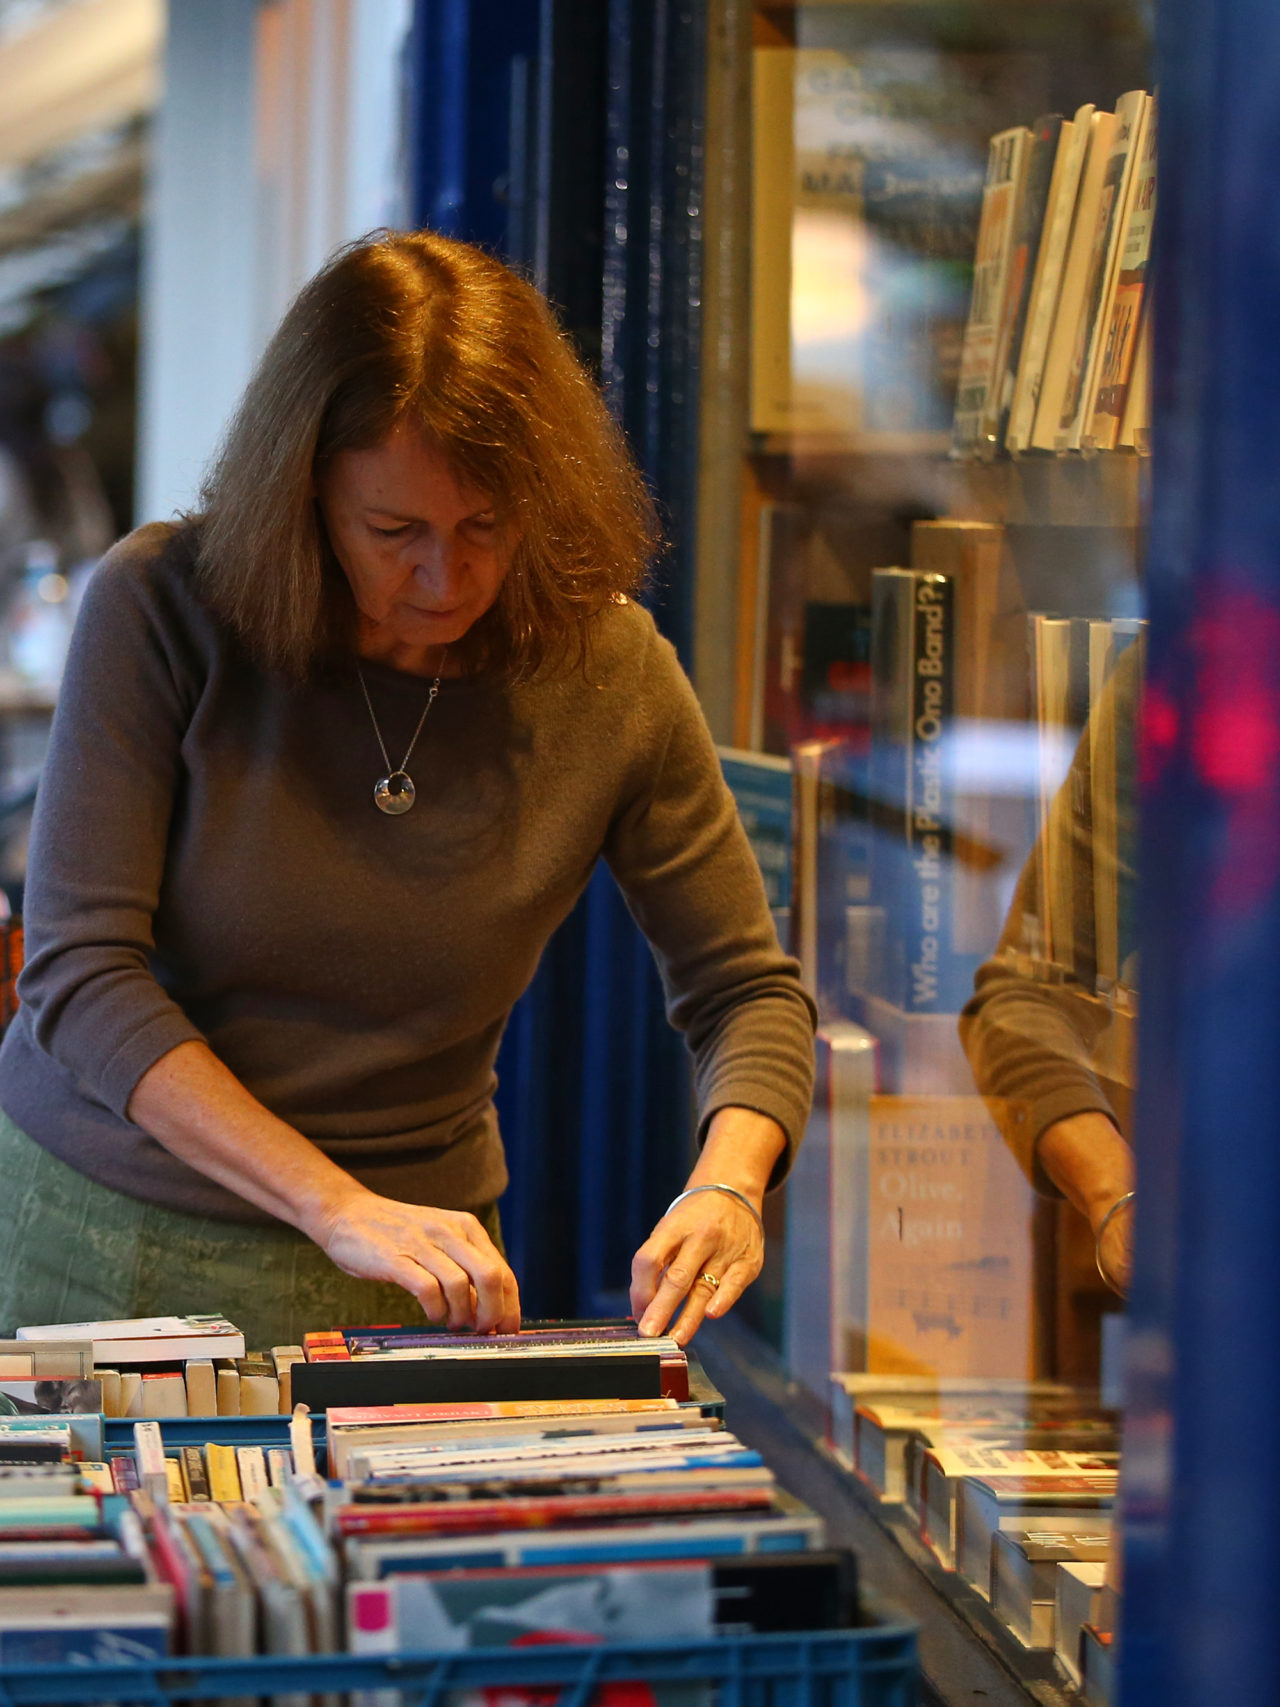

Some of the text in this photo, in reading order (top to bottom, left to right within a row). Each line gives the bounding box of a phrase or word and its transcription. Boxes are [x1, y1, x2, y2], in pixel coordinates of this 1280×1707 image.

[912, 585, 943, 1004] Who are the Plastic Ono Band?
[878, 1124, 1007, 1141] ELIZABETH
[878, 1149, 970, 1166] STROUT
[880, 1171, 963, 1201] Olive,
[880, 1207, 963, 1249] Again
